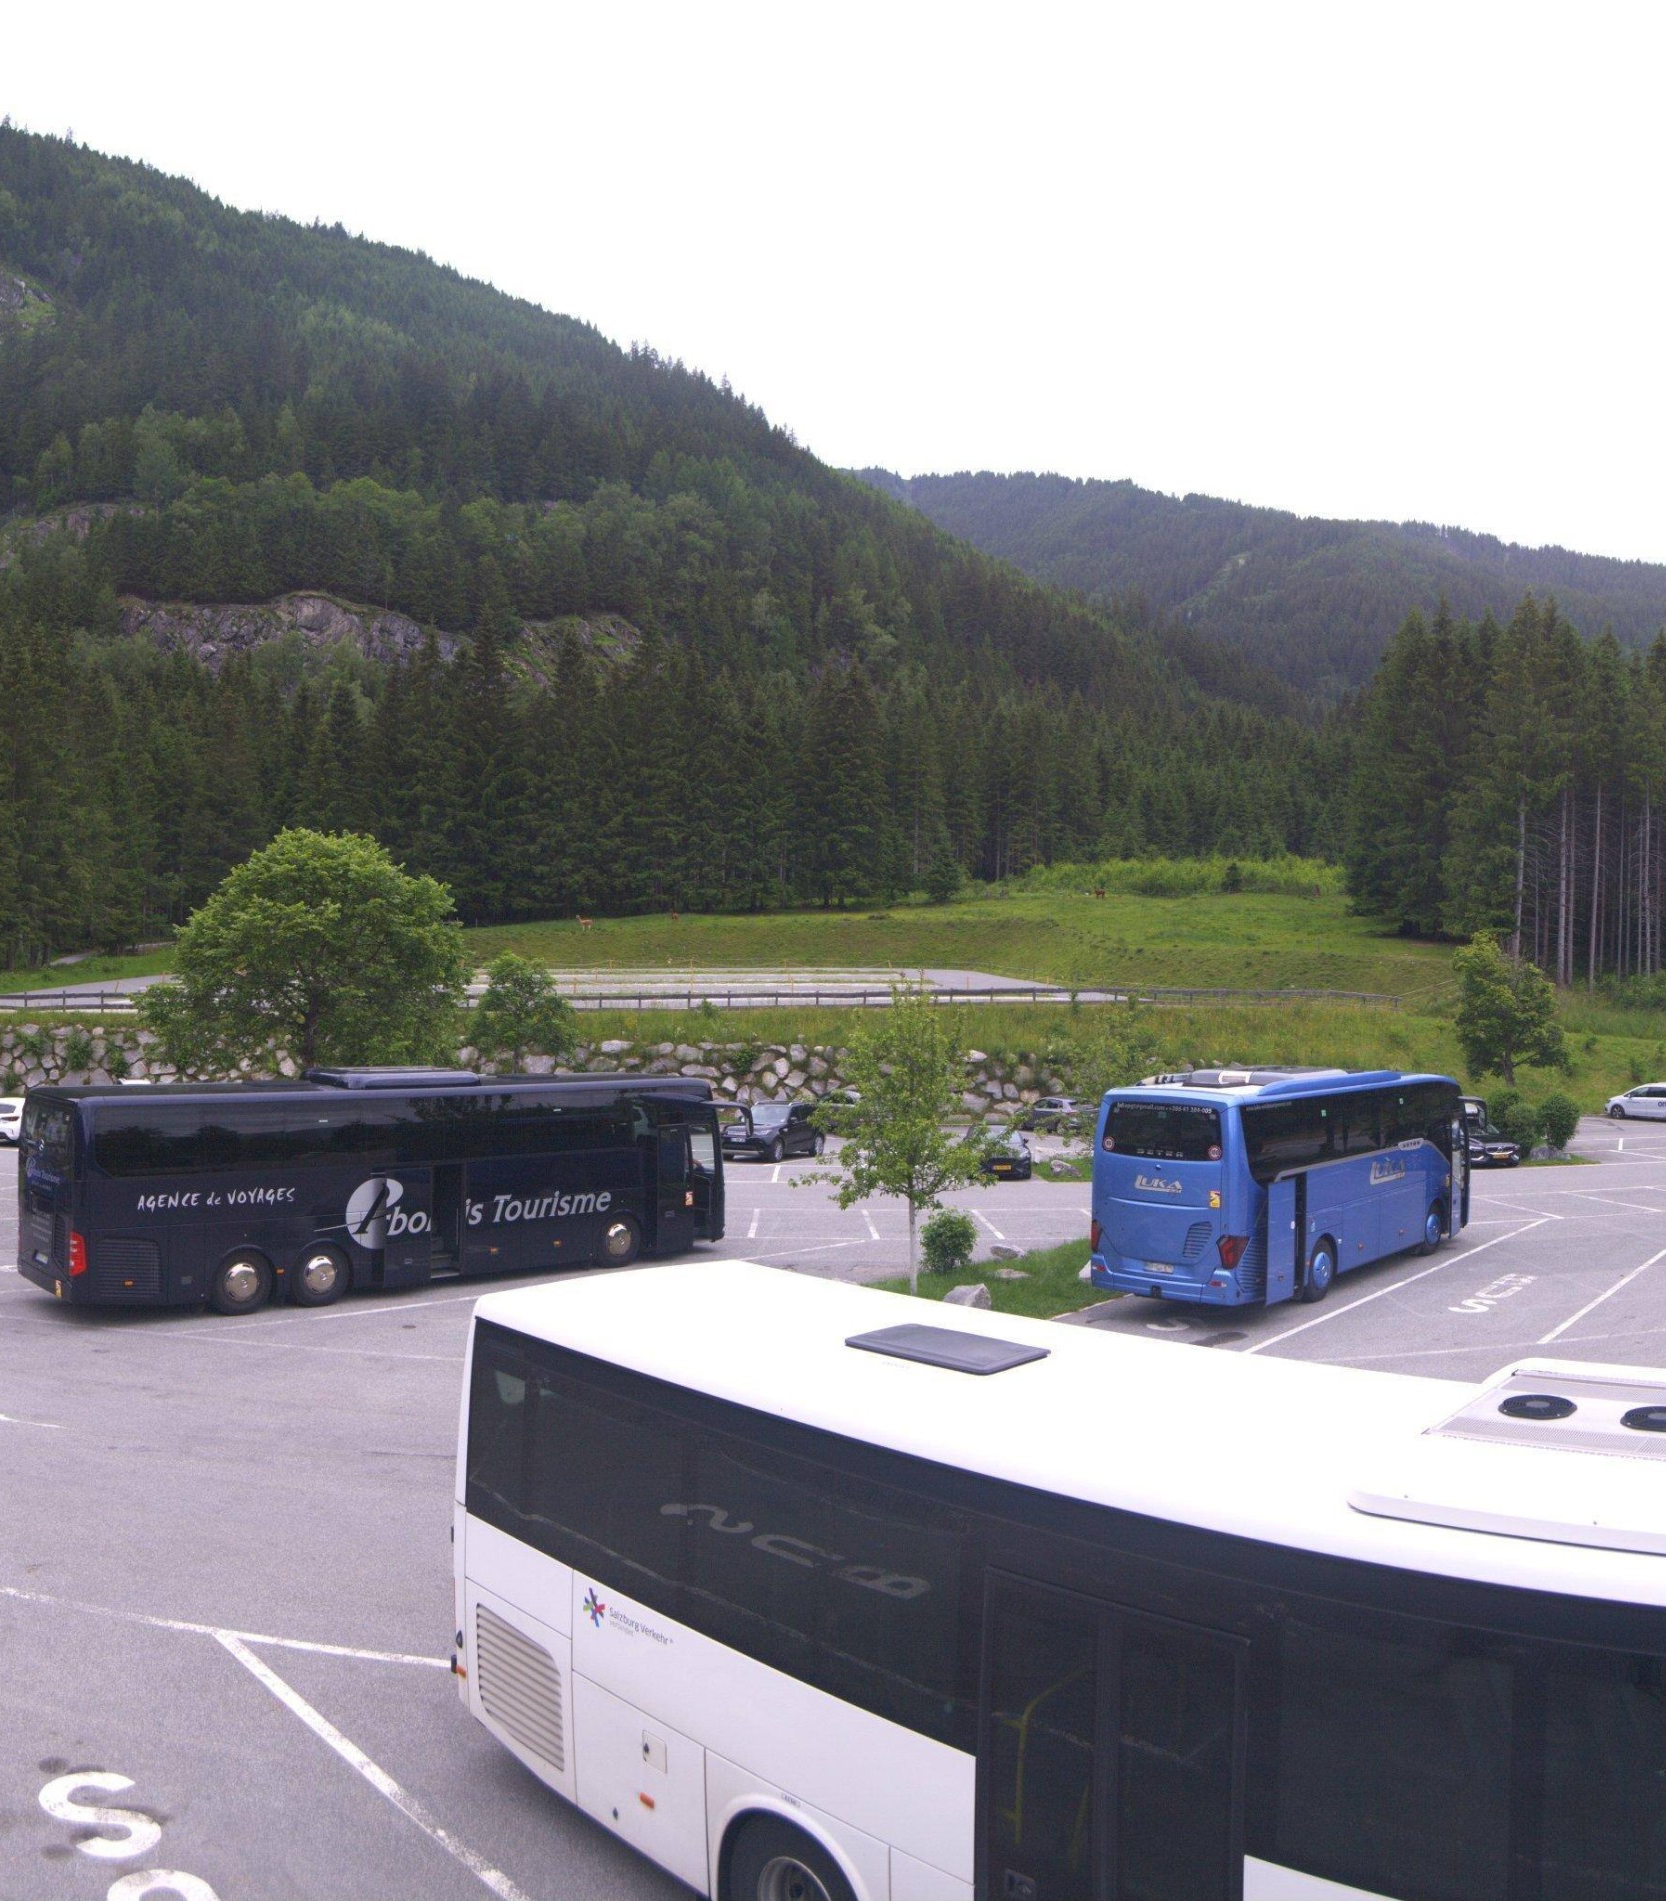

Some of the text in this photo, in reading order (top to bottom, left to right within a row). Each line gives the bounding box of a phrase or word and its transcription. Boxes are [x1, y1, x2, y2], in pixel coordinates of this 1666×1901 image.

[137, 1187, 295, 1212] AGENCE de VOYAGES
[1135, 1175, 1183, 1193] LUKA
[493, 1191, 611, 1223] Tourisme
[1447, 1273, 1538, 1313] BUS
[609, 1606, 669, 1645] Salzburg Verkehr
